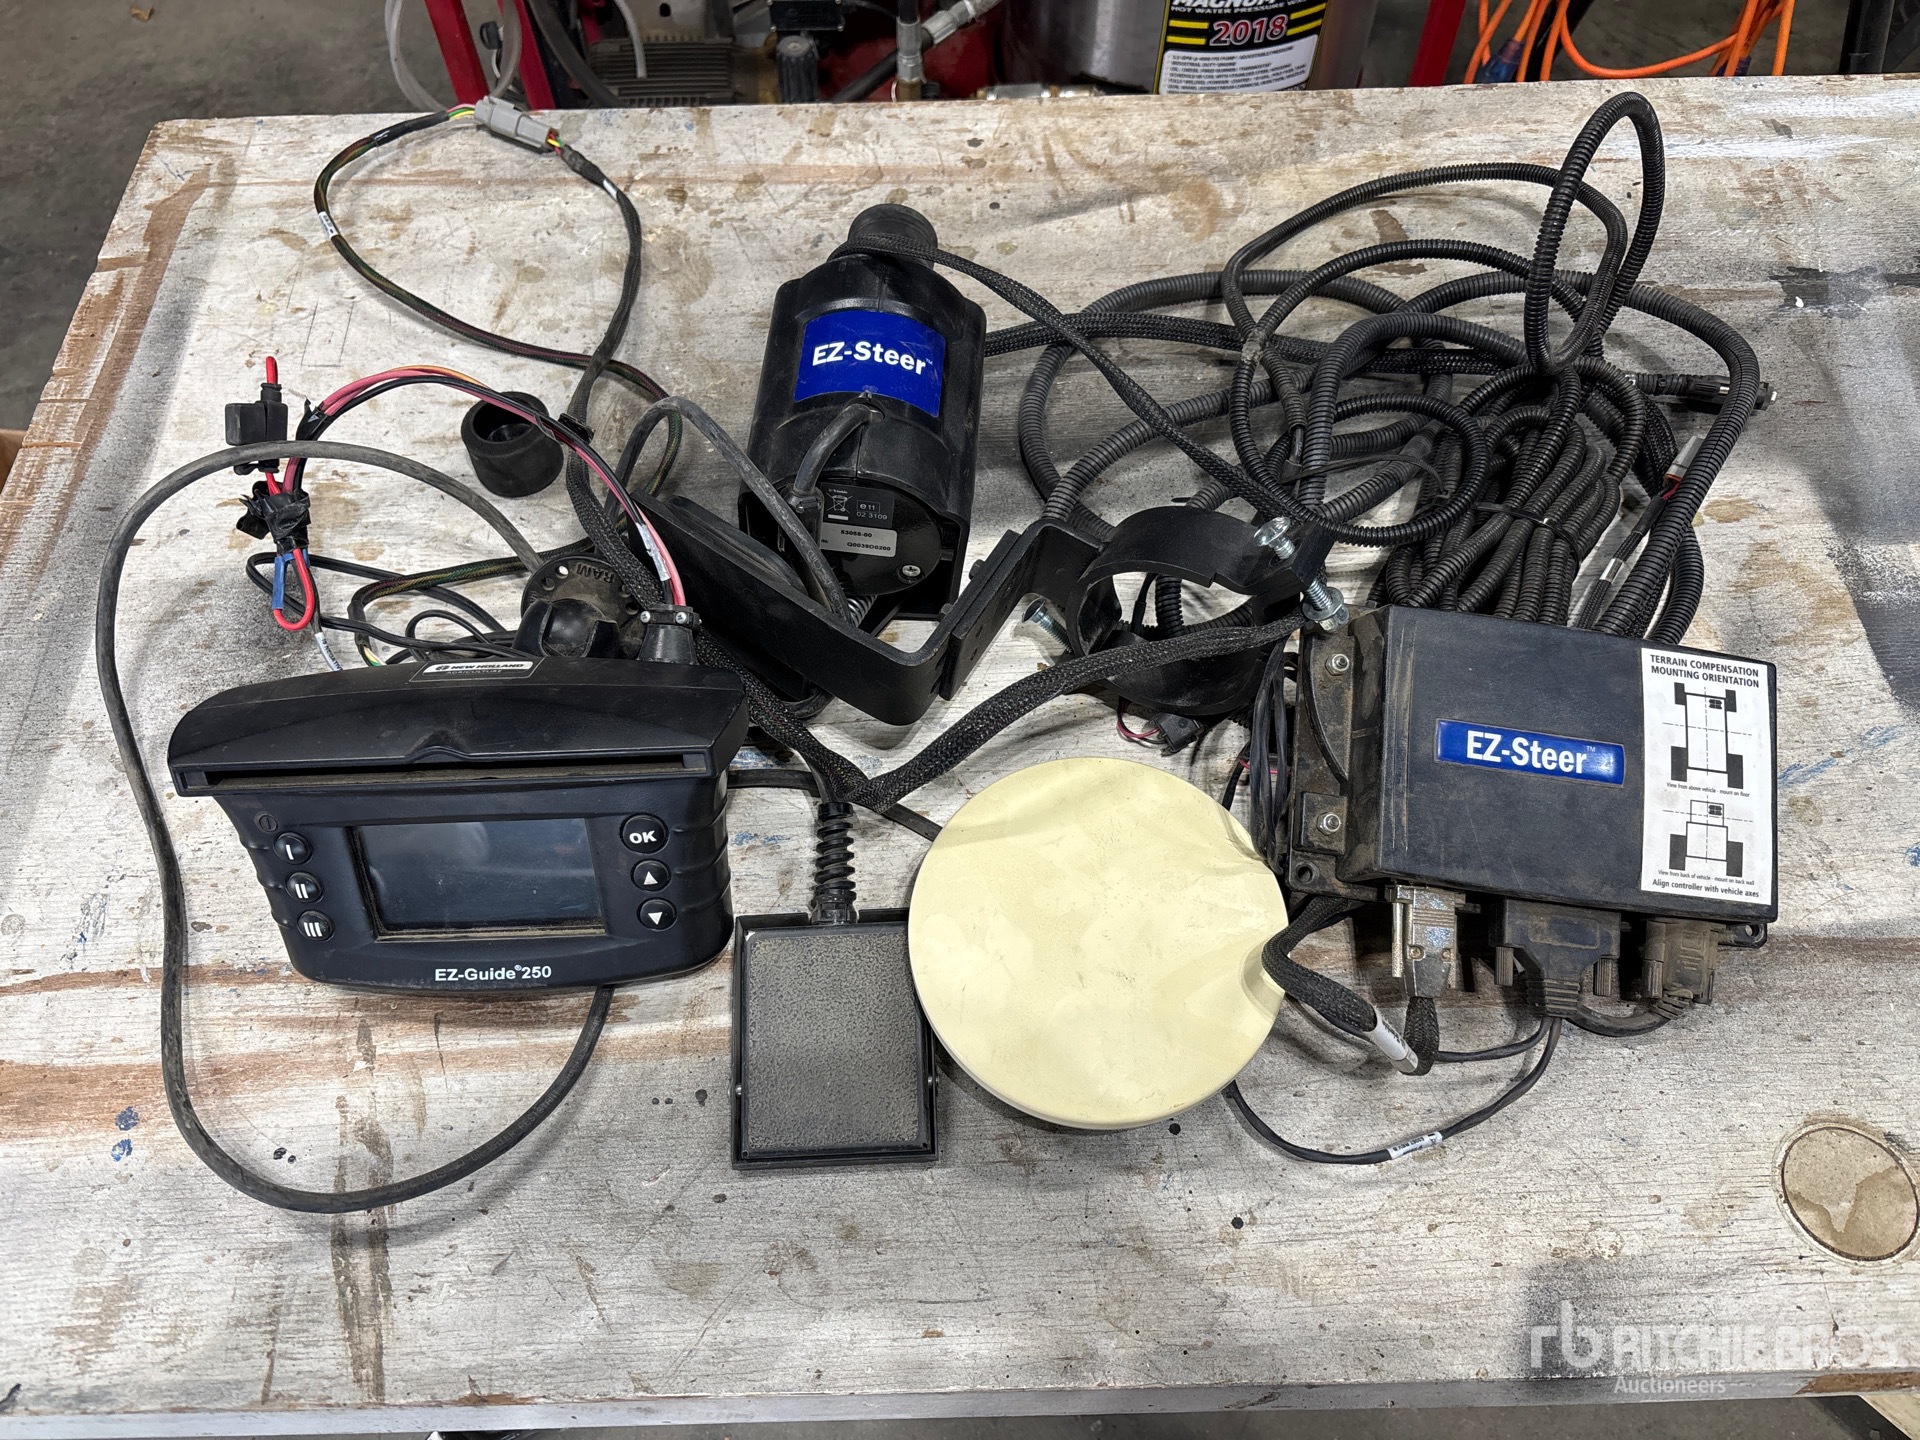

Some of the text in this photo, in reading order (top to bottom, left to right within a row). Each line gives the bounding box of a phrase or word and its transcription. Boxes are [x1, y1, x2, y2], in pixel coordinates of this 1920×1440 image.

[1234, 2, 1285, 13] PRESSURE
[1209, 14, 1288, 46] 2018
[869, 512, 888, 520] 3109
[575, 563, 614, 583] RAM
[1650, 654, 1759, 677] TERRAIN COMPENSATION
[1651, 665, 1759, 688] MOUNTING ORIENTATION
[629, 830, 657, 844] OK
[1652, 878, 1670, 888] Align
[1671, 881, 1702, 891] controller
[1704, 885, 1719, 893] with
[1721, 887, 1743, 896] vehicle
